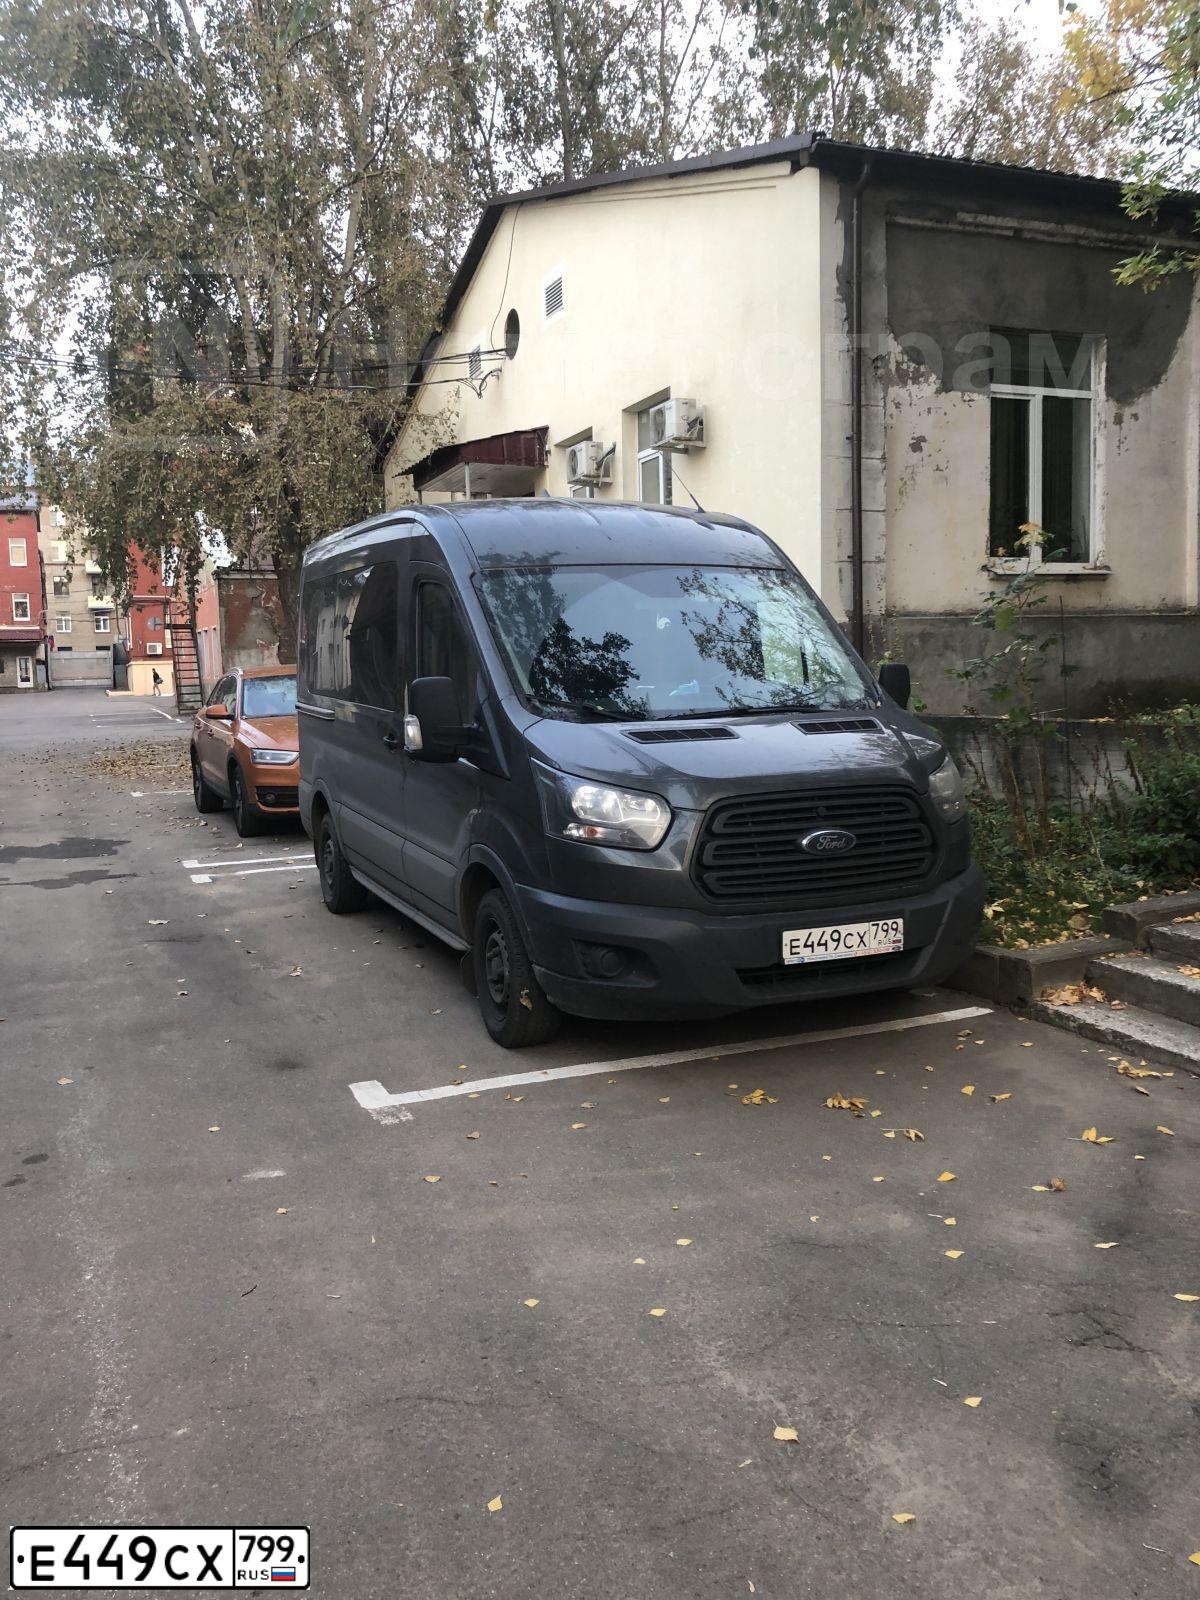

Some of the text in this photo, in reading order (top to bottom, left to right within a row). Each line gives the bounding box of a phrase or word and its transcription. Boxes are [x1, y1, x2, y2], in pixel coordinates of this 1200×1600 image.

[816, 835, 846, 850] Ford
[789, 920, 900, 956] Е449СХ 799
[877, 937, 893, 946] RUS
